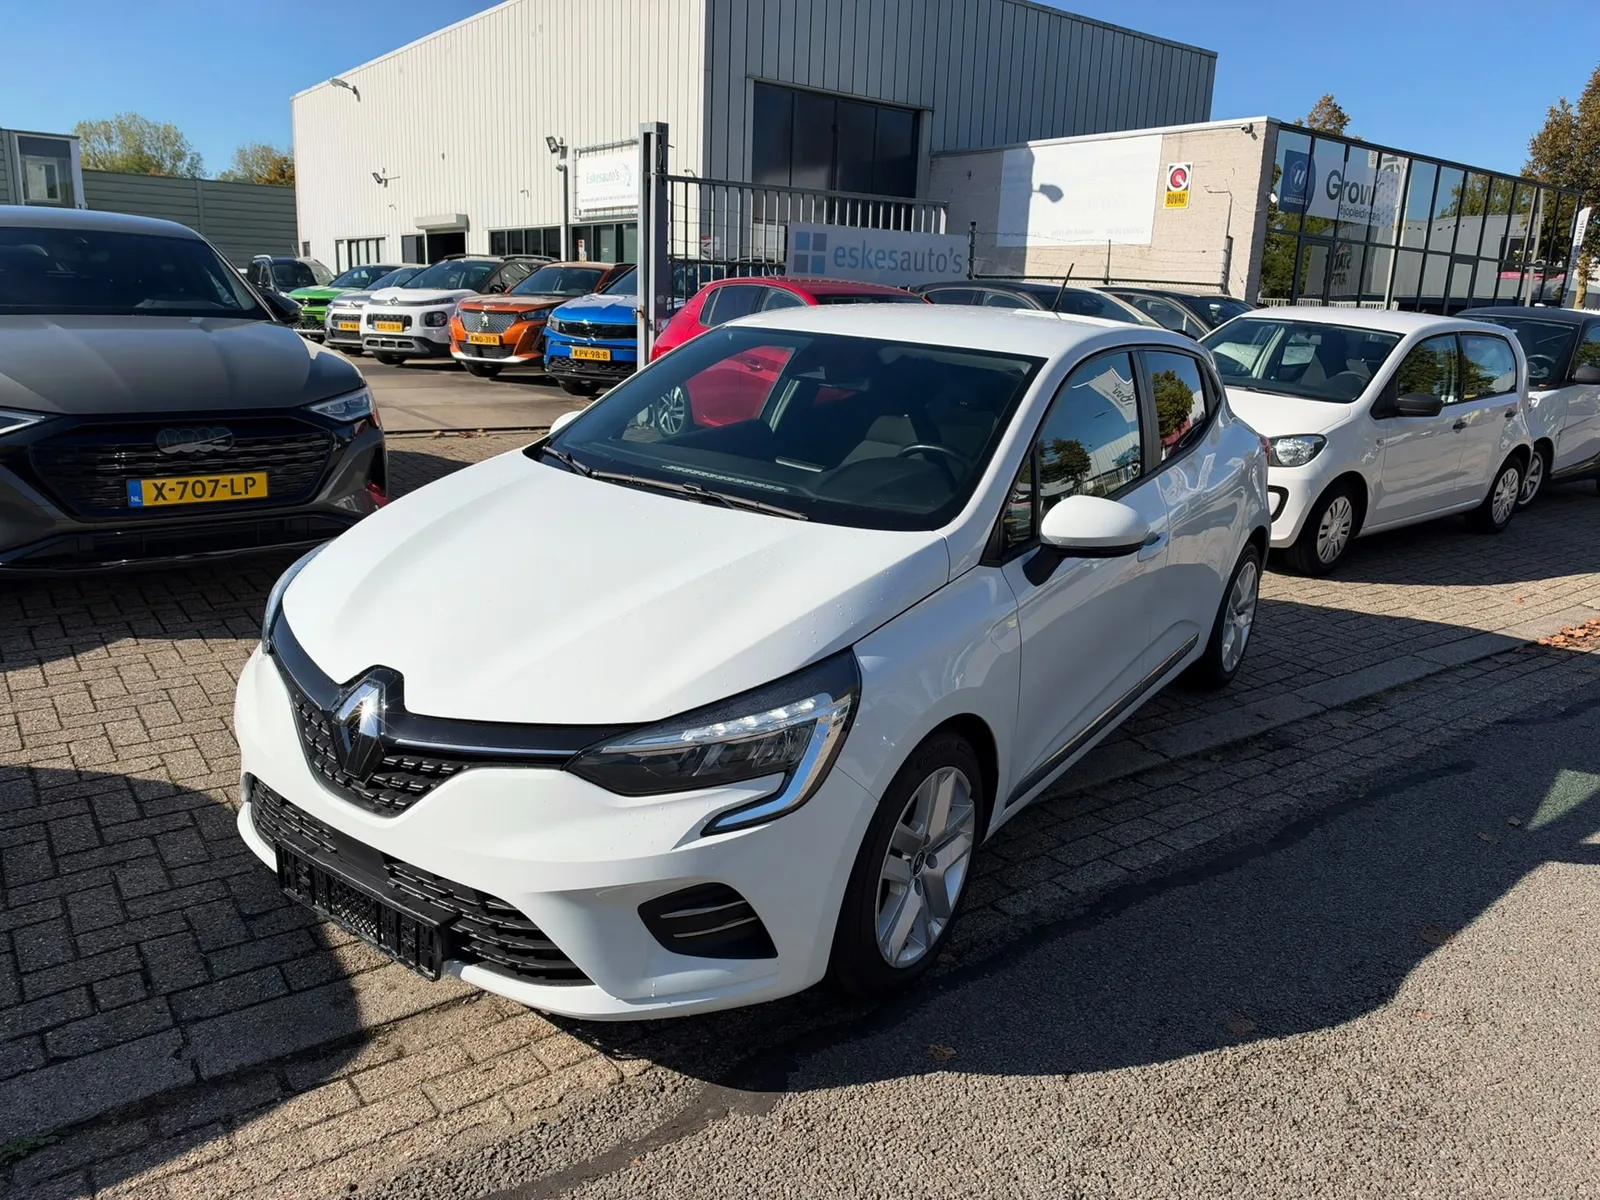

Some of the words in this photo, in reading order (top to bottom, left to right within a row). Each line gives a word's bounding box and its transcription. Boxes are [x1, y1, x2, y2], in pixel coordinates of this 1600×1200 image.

[833, 239, 963, 274] eskesauto's
[573, 349, 608, 359] KPV-98-B
[152, 476, 257, 501] X-707-LP
